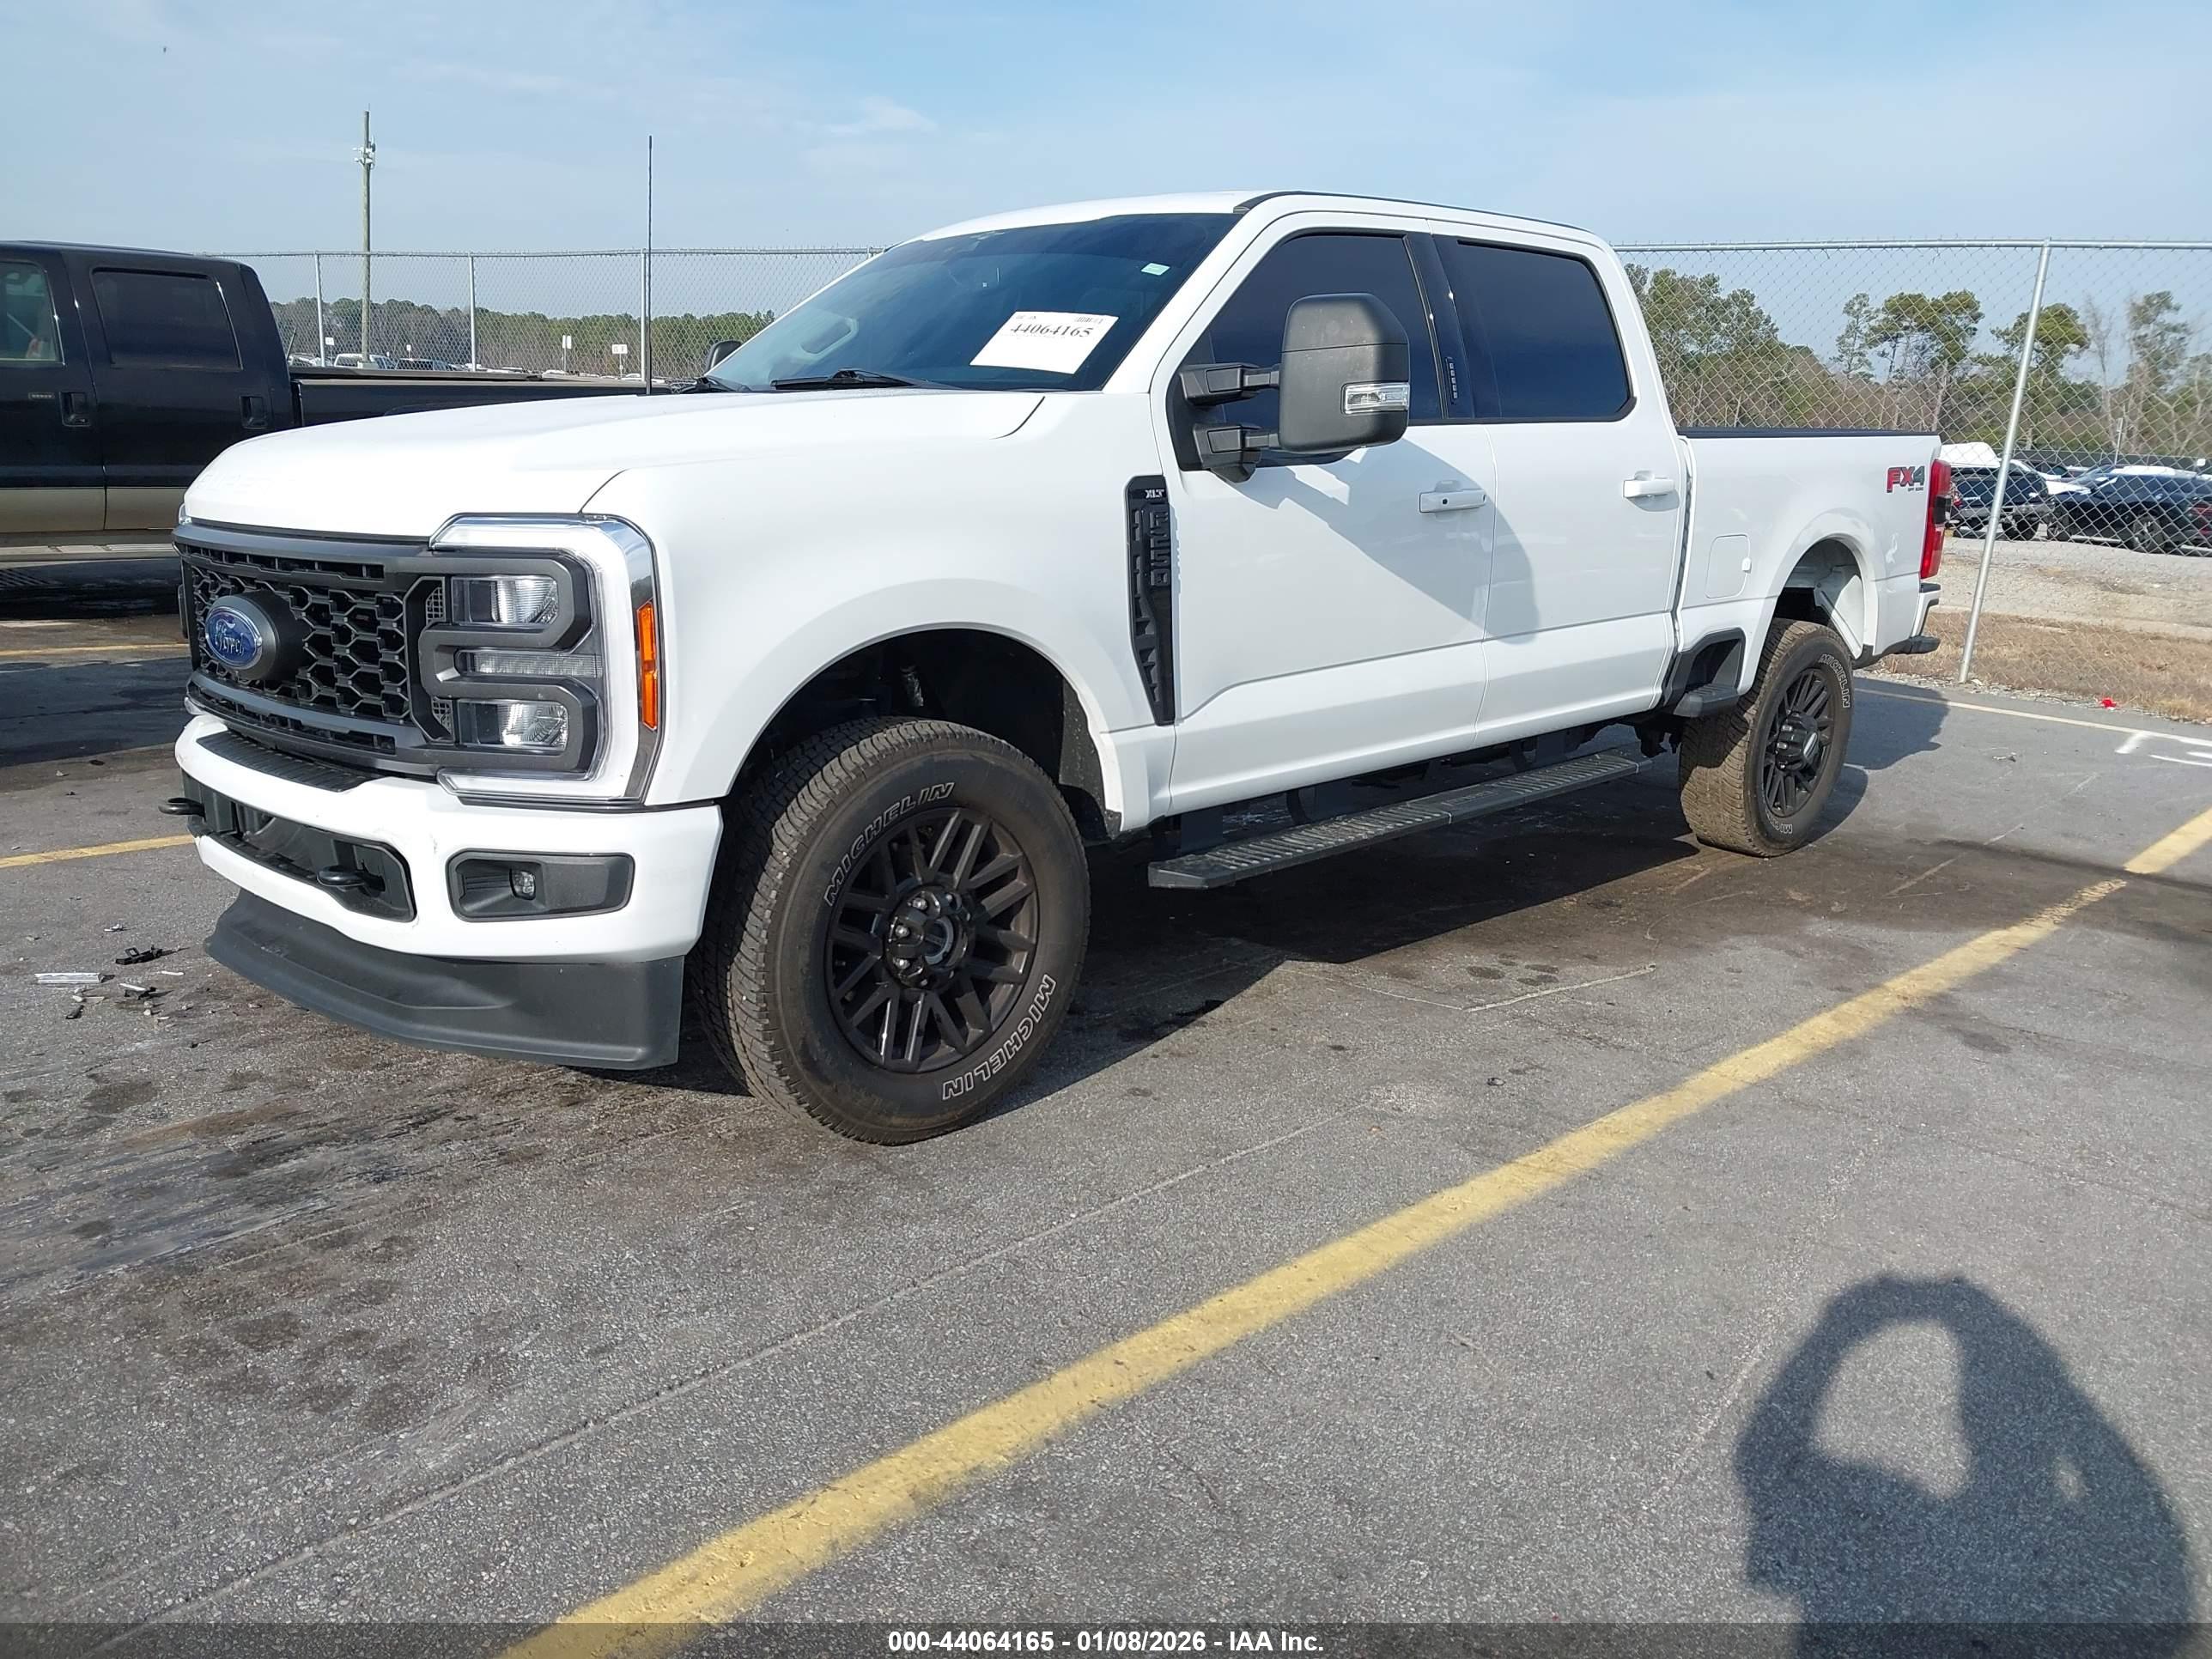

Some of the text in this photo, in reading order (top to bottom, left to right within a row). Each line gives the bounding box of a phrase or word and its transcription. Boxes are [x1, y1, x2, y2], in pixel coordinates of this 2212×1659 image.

[1010, 324, 1094, 337] 44064165
[1887, 465, 1925, 493] FX4
[1819, 653, 1850, 708] MICHELIN
[824, 782, 955, 907] MICHELIN
[943, 974, 1056, 1100] MICHELIN
